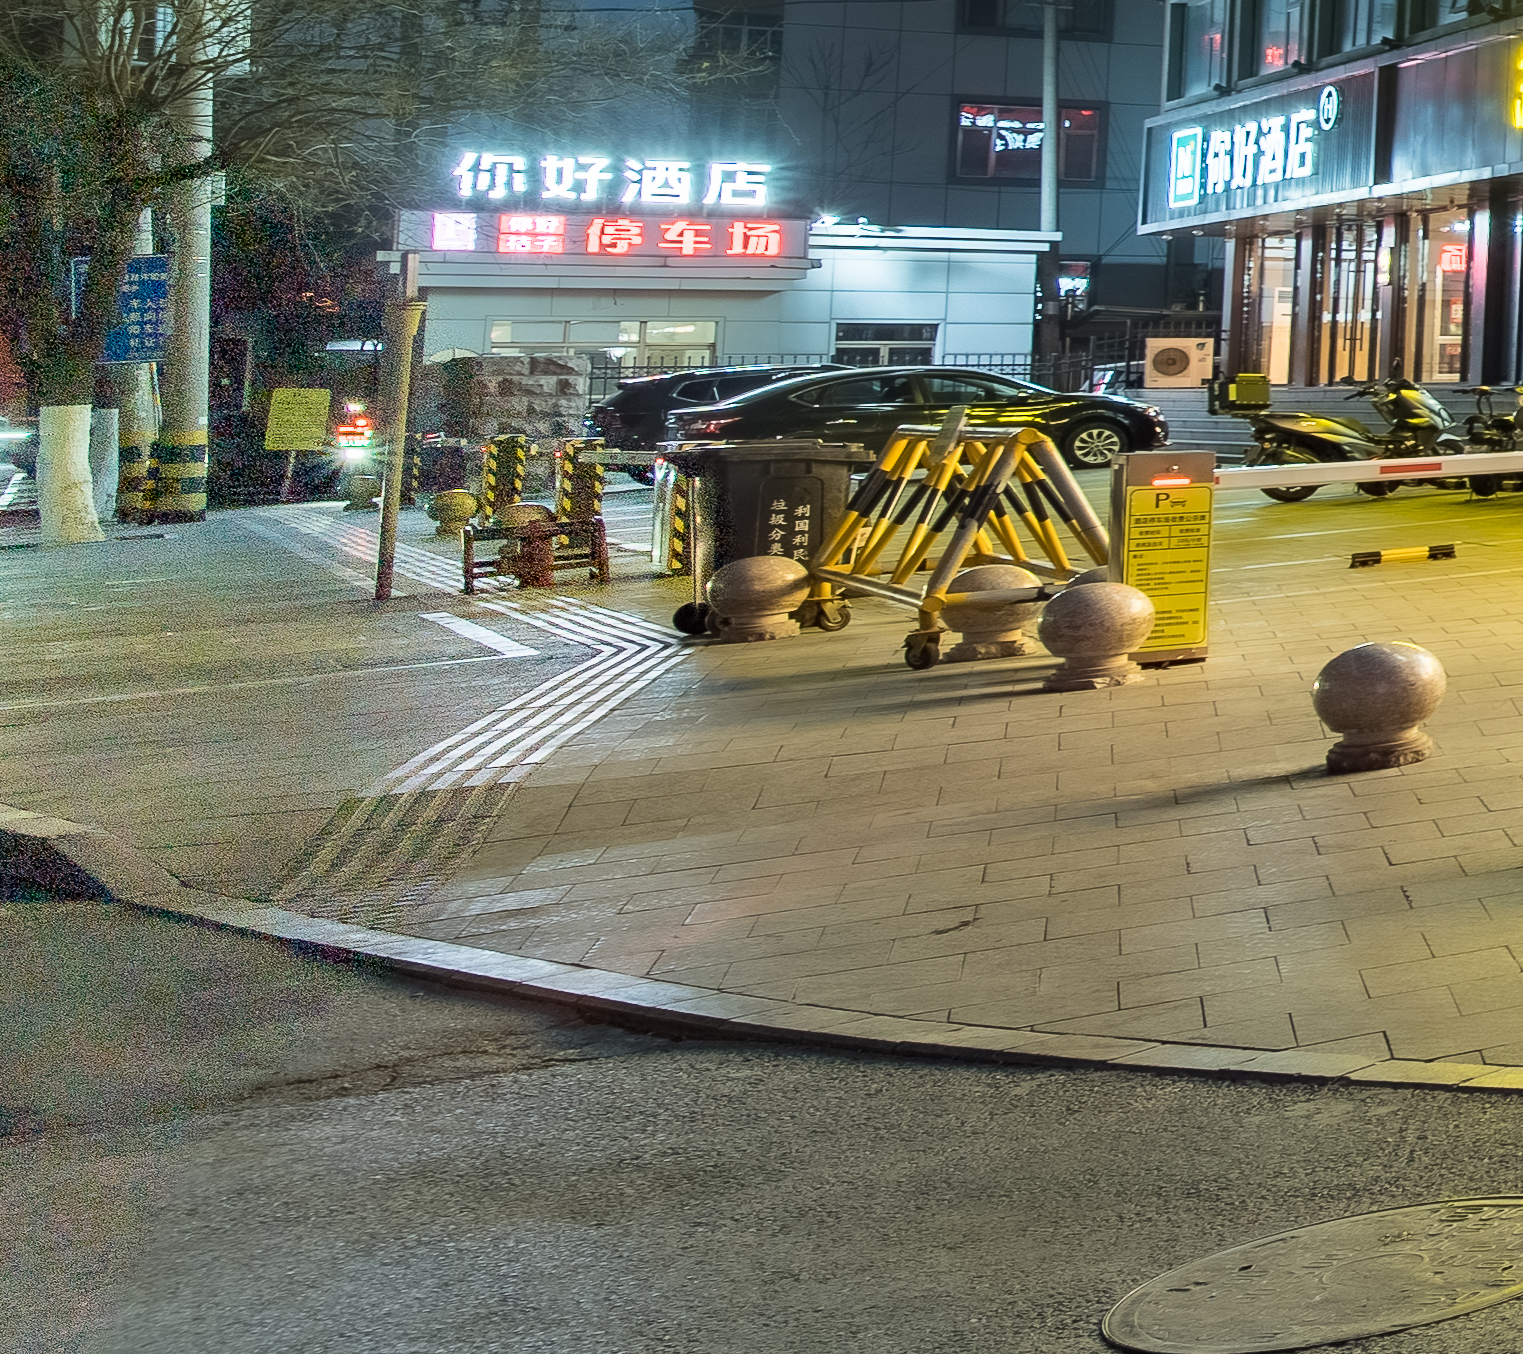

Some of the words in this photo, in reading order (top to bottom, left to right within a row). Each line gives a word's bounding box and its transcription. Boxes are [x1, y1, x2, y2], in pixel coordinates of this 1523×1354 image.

[1205, 107, 1317, 194] 你好酒店
[452, 151, 772, 206] 你好酒店
[506, 235, 559, 251] 桔子
[508, 216, 560, 232] 你好
[586, 218, 782, 256] 停车场
[1155, 492, 1170, 509] P
[792, 504, 811, 561] 利国利民
